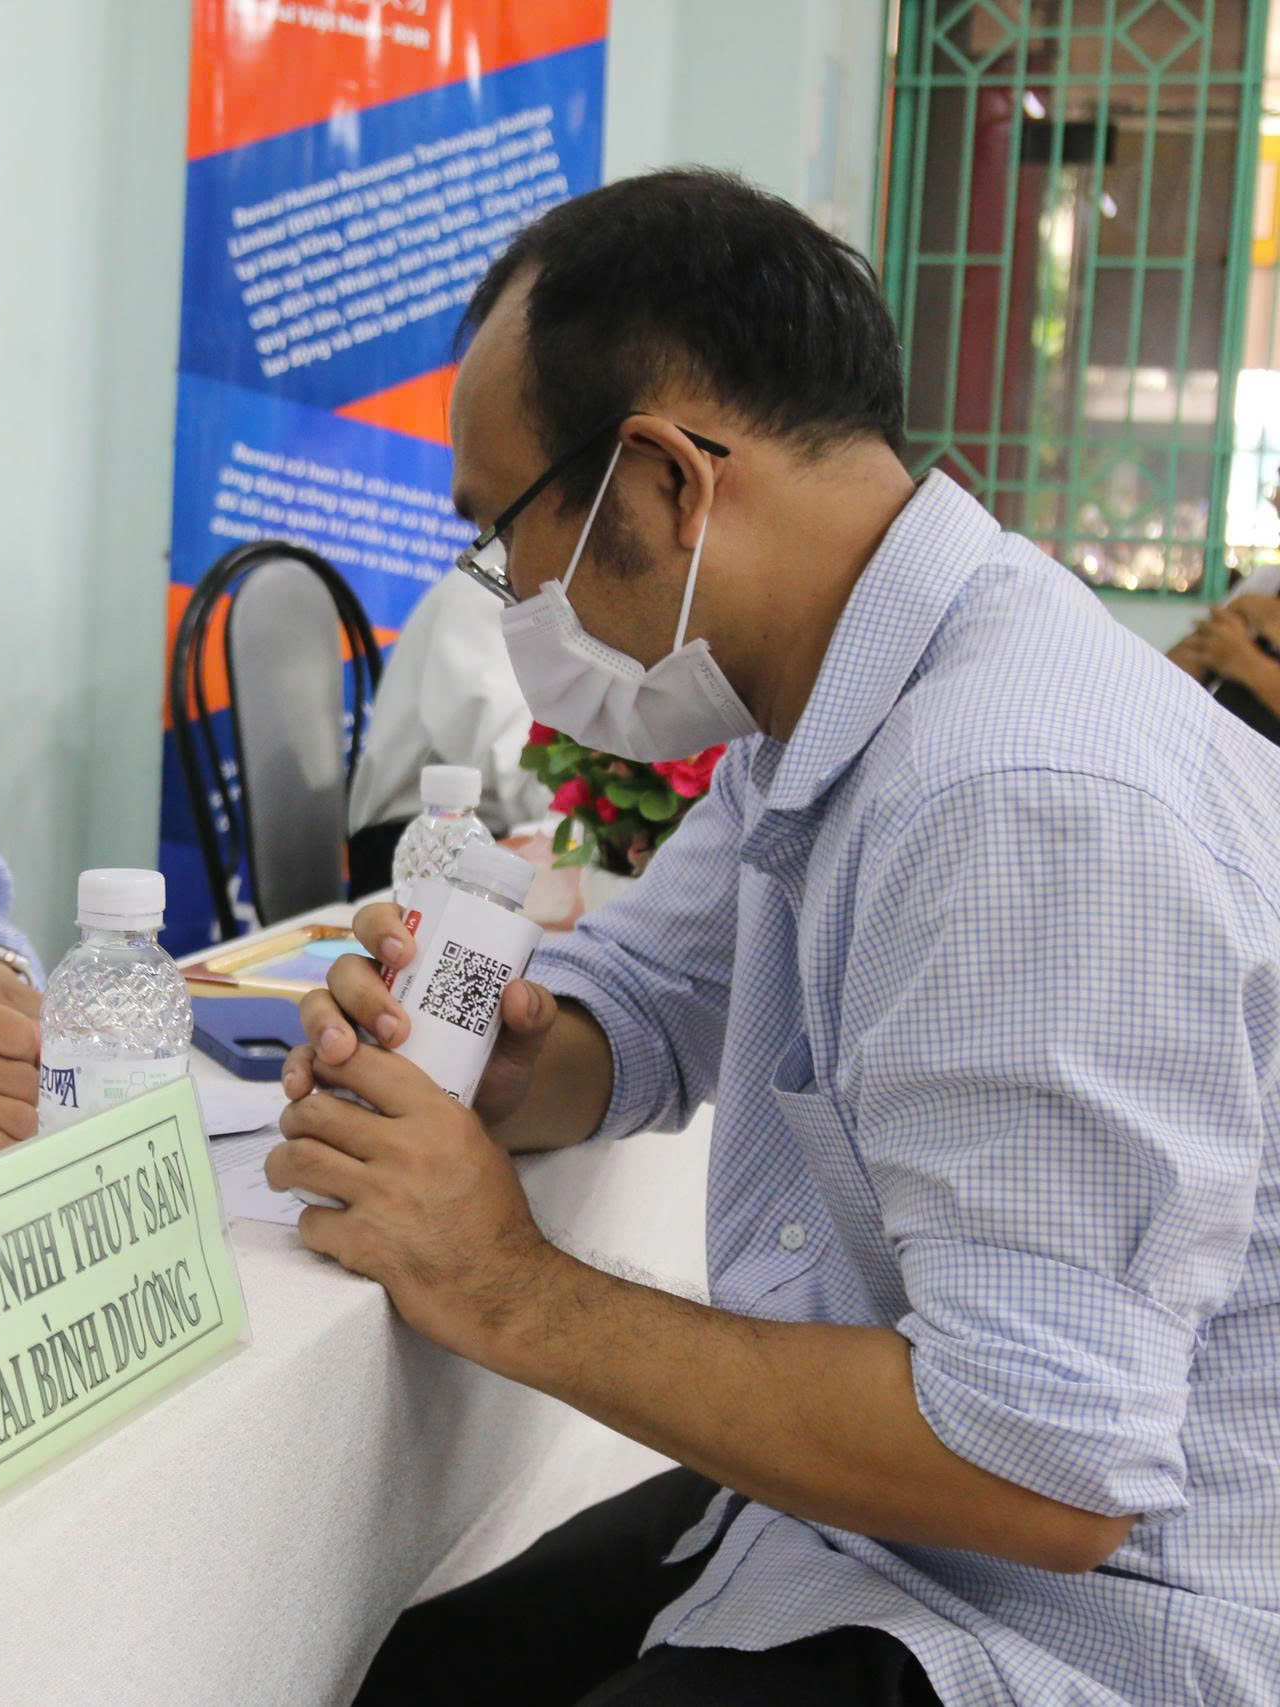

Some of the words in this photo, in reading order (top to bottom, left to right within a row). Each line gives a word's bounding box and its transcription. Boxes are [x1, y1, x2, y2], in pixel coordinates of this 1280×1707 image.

[229, 222, 285, 256] Limited
[59, 1164, 140, 1274] THỦY
[137, 1140, 191, 1236] SẢN
[28, 1313, 110, 1418] BÌNH
[103, 1258, 203, 1373] DƯƠNG
